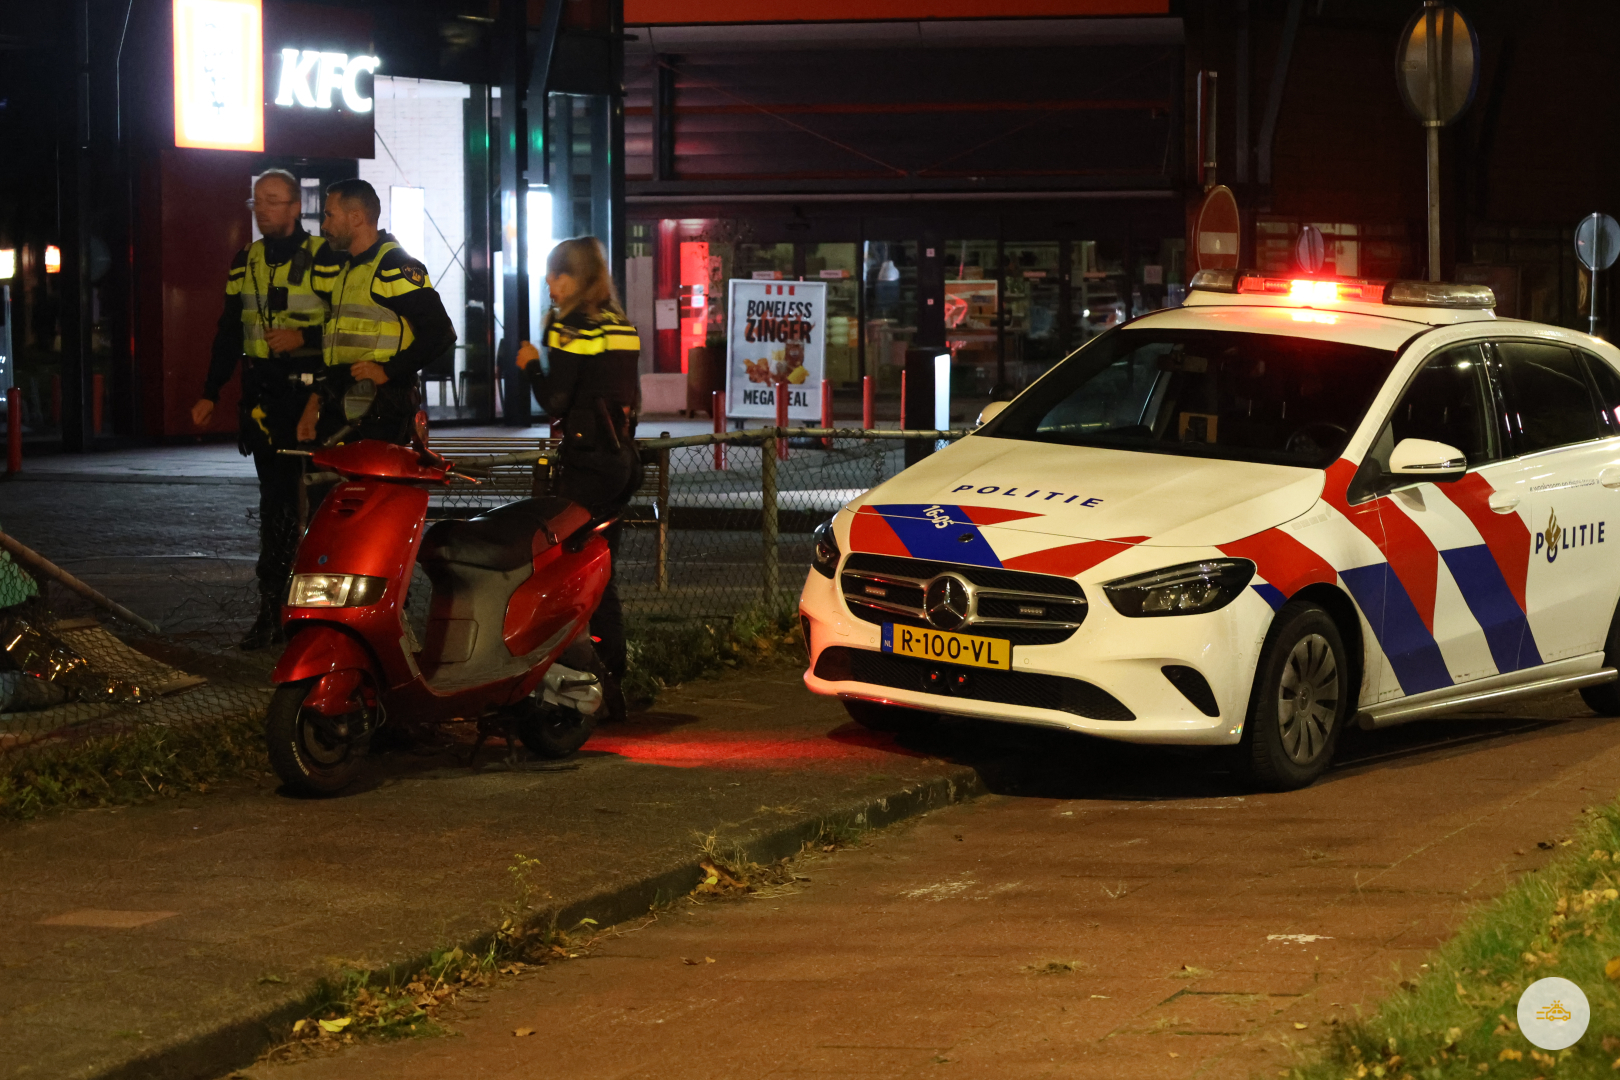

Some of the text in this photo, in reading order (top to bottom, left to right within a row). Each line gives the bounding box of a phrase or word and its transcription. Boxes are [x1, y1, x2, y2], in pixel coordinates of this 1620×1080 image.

[275, 48, 380, 112] KFC
[747, 300, 813, 319] BONELESS
[745, 318, 812, 344] ZINGER
[743, 390, 808, 407] MEGA EAL
[951, 484, 1104, 508] POLITIE
[923, 504, 954, 529] 16-05
[1535, 521, 1605, 563] POLITIE
[884, 629, 999, 665] NL R-100-VL
